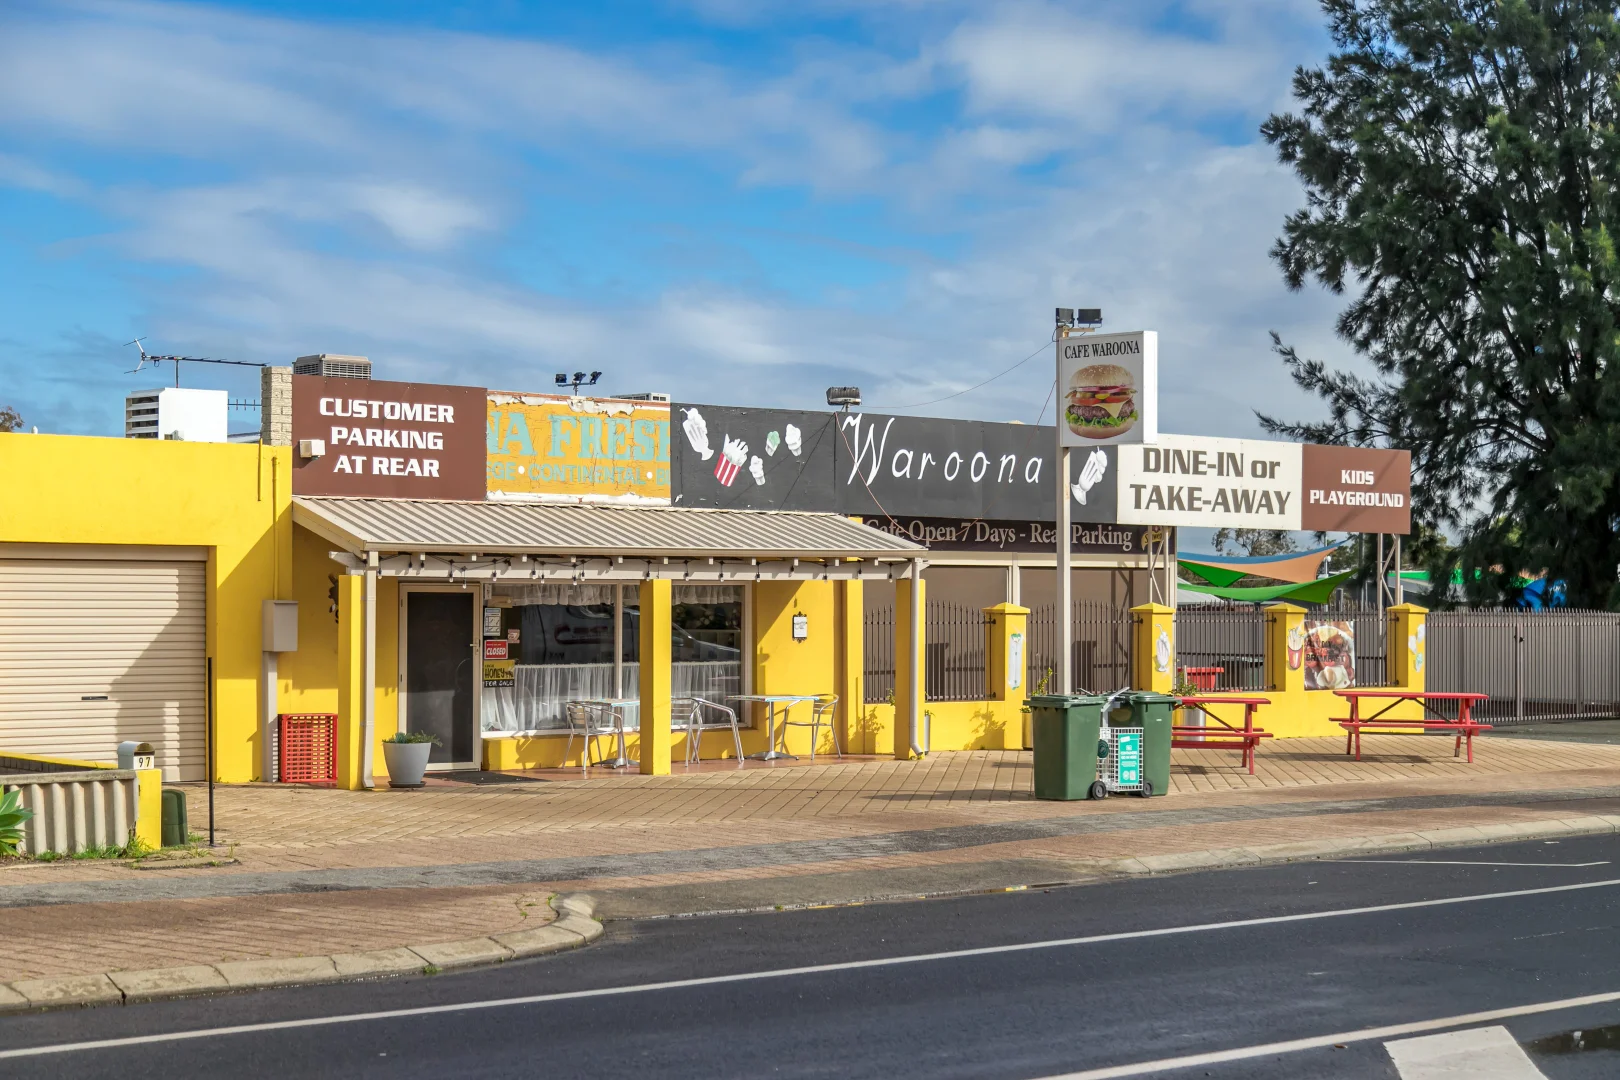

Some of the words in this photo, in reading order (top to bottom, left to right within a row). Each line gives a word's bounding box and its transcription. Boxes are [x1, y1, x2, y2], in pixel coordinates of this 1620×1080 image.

[1065, 344, 1089, 359] CAFE
[1091, 340, 1140, 357] WAROONA
[319, 397, 455, 424] CUSTOMER
[330, 426, 444, 450] PARKING
[842, 413, 1042, 487] Waroona
[333, 455, 367, 475] AT
[372, 456, 440, 478] REAR
[528, 463, 646, 485] CONTINENTAL
[1142, 447, 1244, 477] DINE-IN
[1250, 459, 1281, 479] or
[1341, 470, 1374, 485] KIDS
[1129, 483, 1291, 515] TAKE-AWAY
[1309, 489, 1404, 508] PLAYGROUND
[908, 520, 957, 548] Open
[960, 522, 972, 541] 7
[975, 522, 1016, 549] Days
[1030, 523, 1057, 543] Rea
[1071, 523, 1132, 551] Parking
[486, 647, 507, 656] CLOSED
[138, 757, 151, 768] 97
